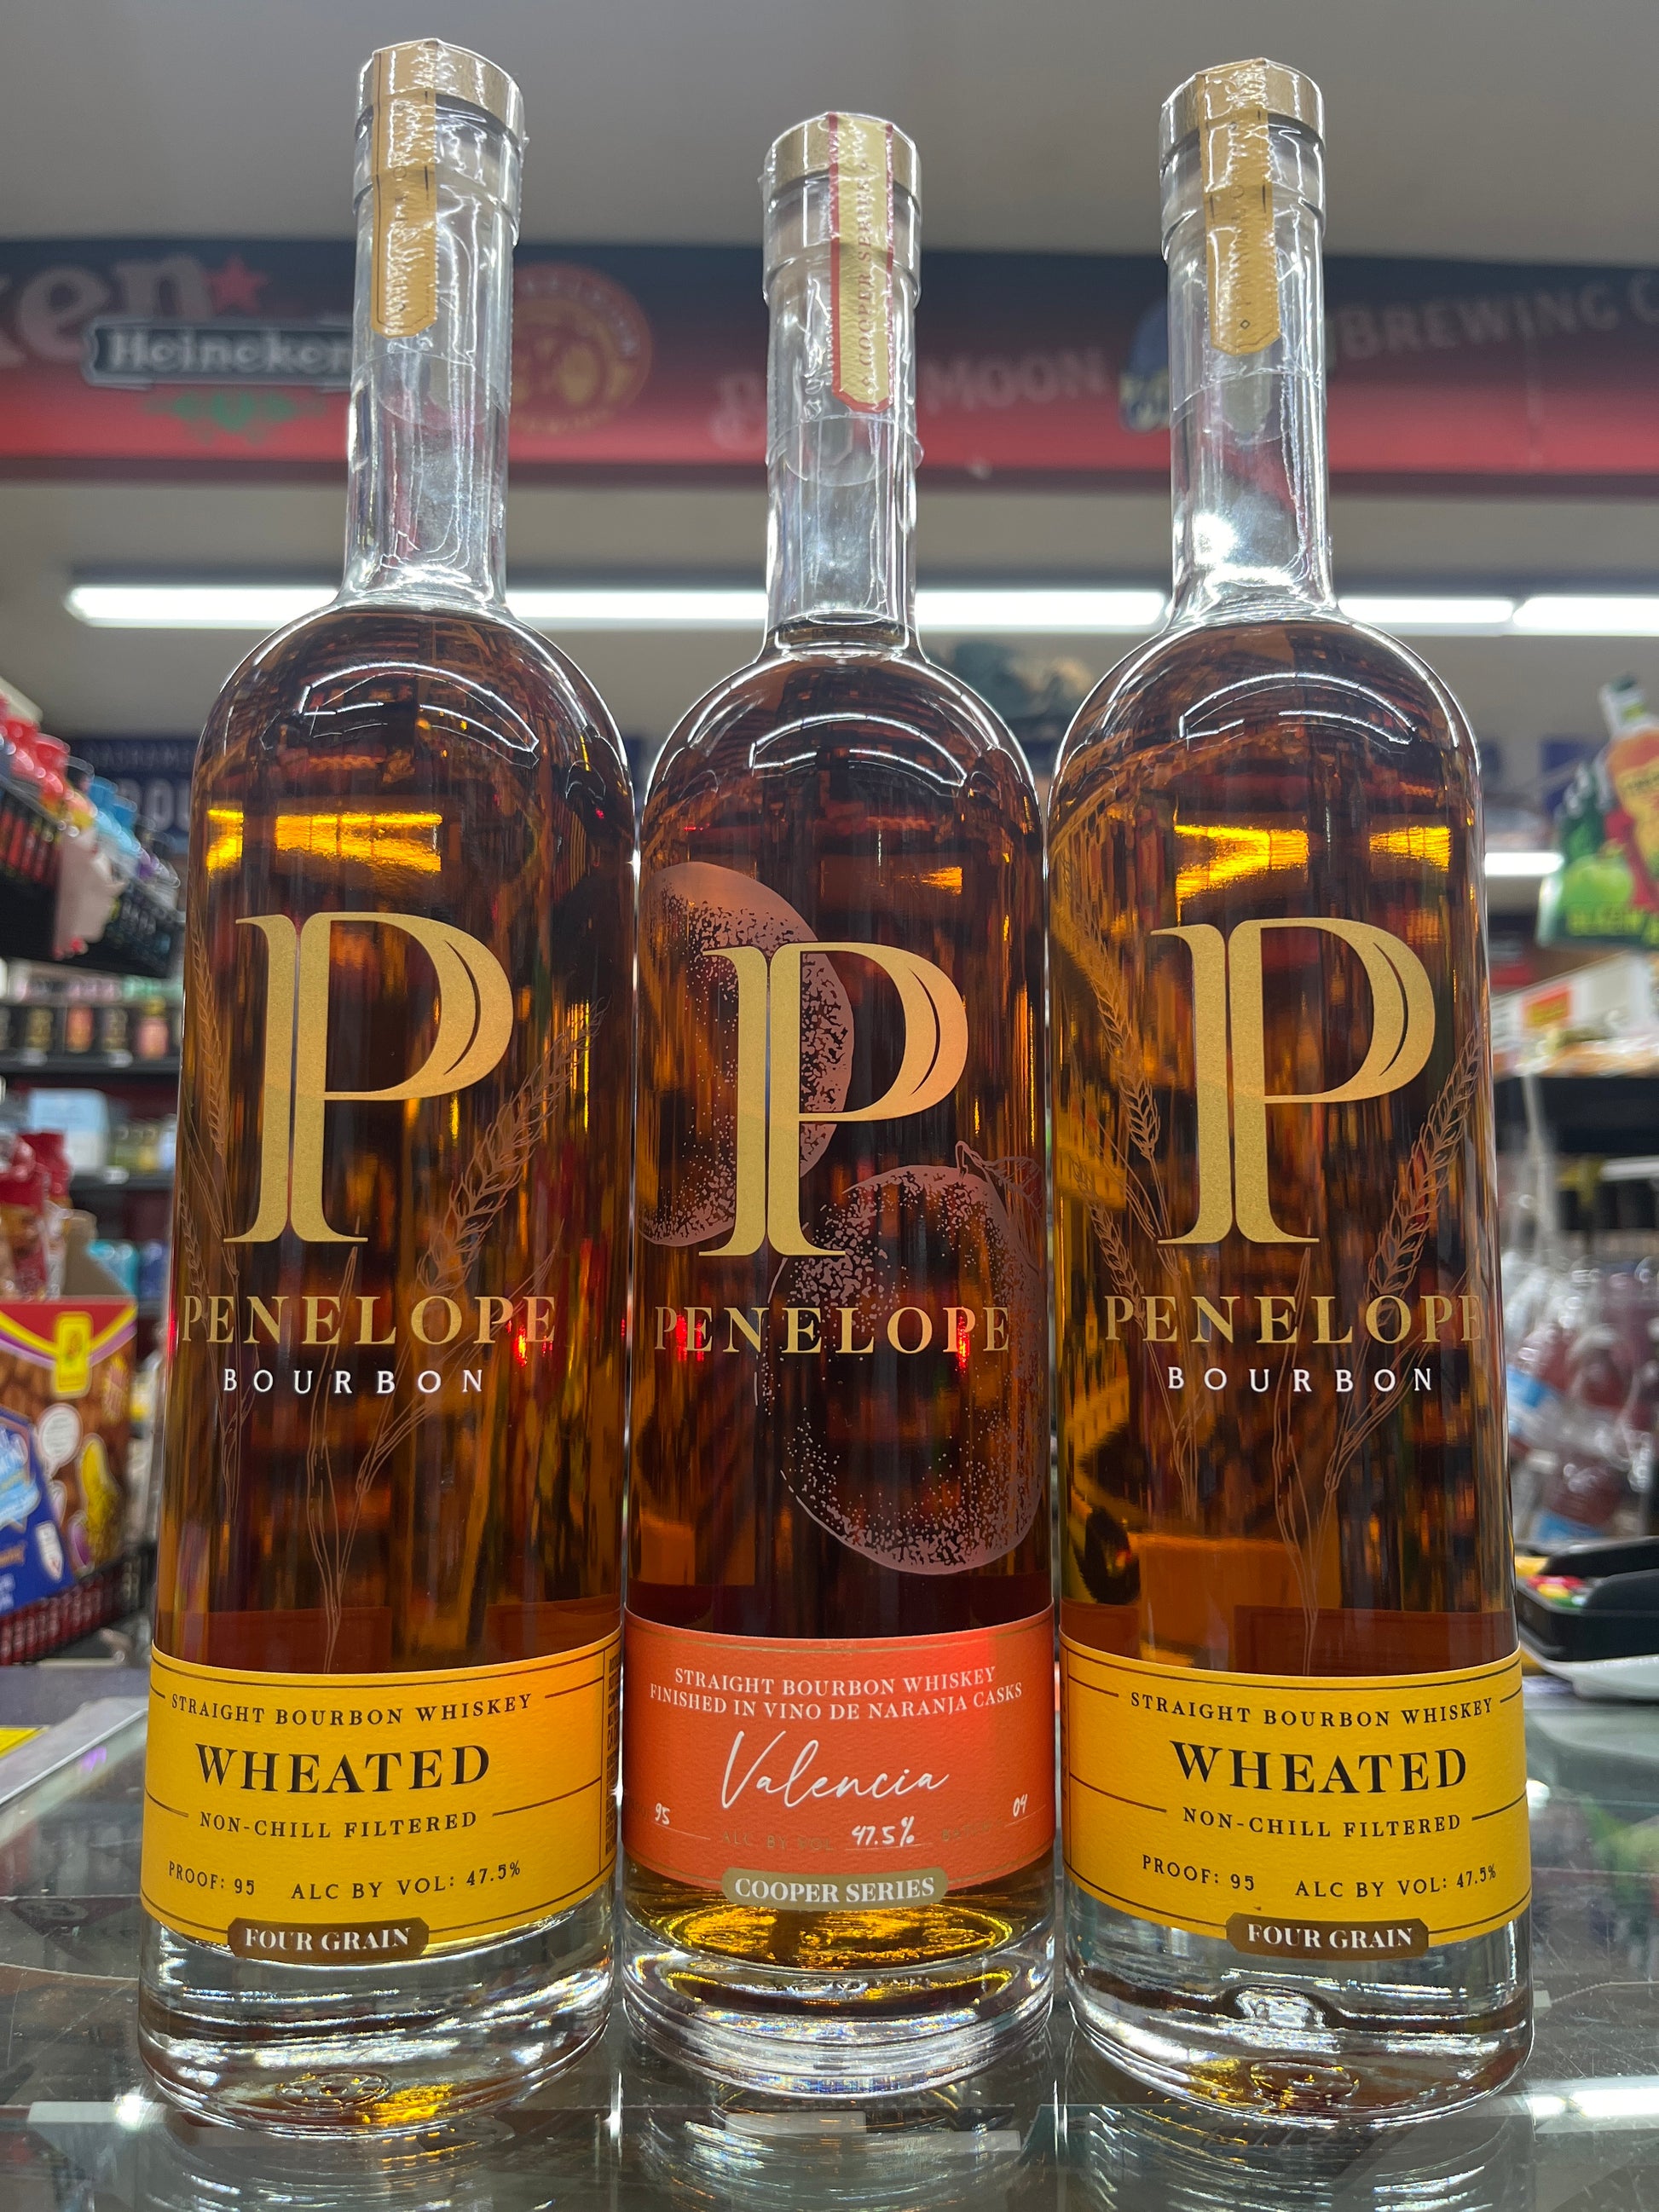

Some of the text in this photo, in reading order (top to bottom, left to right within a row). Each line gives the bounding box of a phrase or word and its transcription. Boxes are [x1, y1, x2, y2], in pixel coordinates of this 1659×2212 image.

[858, 274, 875, 366] COOPER
[182, 1295, 556, 1346] PENELOPE
[655, 1306, 1009, 1354] PENELOPE
[1105, 1295, 1483, 1344] PENELOPE
[223, 1367, 484, 1395] BOURBON
[1168, 1366, 1432, 1393] BOURBON
[674, 1666, 996, 1697] STRAIGHT BOURBON WHISKEY
[171, 1693, 532, 1726] STRAIGHT BOURBON WHISKEY
[650, 1682, 1022, 1720] FINISHED IN VINO DE NARANJA CASKS
[1130, 1691, 1493, 1728] STRAIGHT BOURBON WHISKEY
[195, 1742, 491, 1794] WHEATED
[721, 1730, 950, 1810] Valencia
[1169, 1740, 1466, 1794] WHEATED
[199, 1811, 477, 1839] NON-CHILL FILTERED
[654, 1802, 671, 1825] 95
[851, 1816, 915, 1847] 47.5%
[1182, 1806, 1461, 1838] NON-CHILL FILTERED
[168, 1860, 522, 1900] PROOF: 95 ALC BY VOL: 47.5%
[734, 1876, 935, 1903] COOPER SERIES
[1142, 1854, 1497, 1898] PROOF: 95 ALC BY VOL: 47.5%
[245, 1926, 412, 1952] FOUR GRAIN
[1247, 1923, 1413, 1949] FOUR GRAIN
